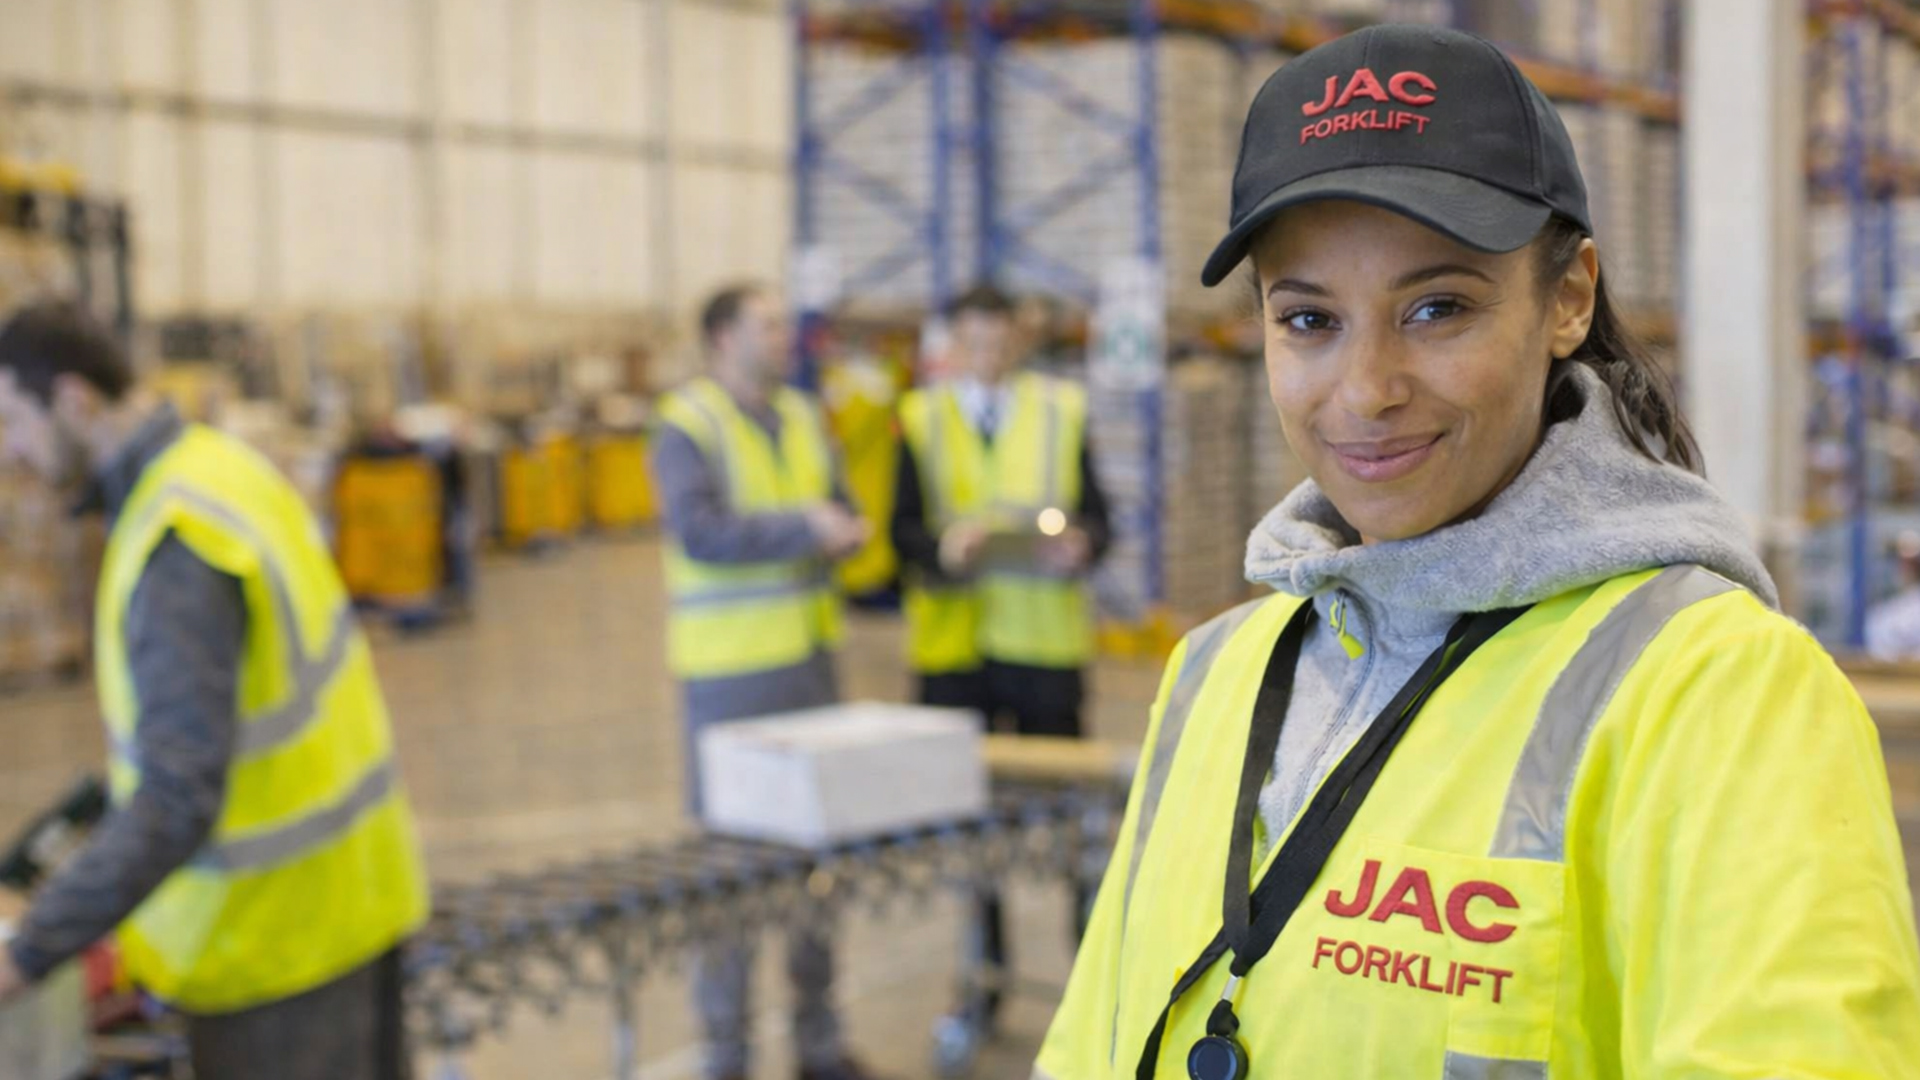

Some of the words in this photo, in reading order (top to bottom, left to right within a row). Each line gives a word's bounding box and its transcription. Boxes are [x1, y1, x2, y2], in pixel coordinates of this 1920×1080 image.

[1302, 68, 1437, 116] JAC
[1300, 109, 1430, 144] FORKLIFT
[1325, 859, 1520, 943] JAC
[1313, 936, 1512, 1002] FORKLIFT
